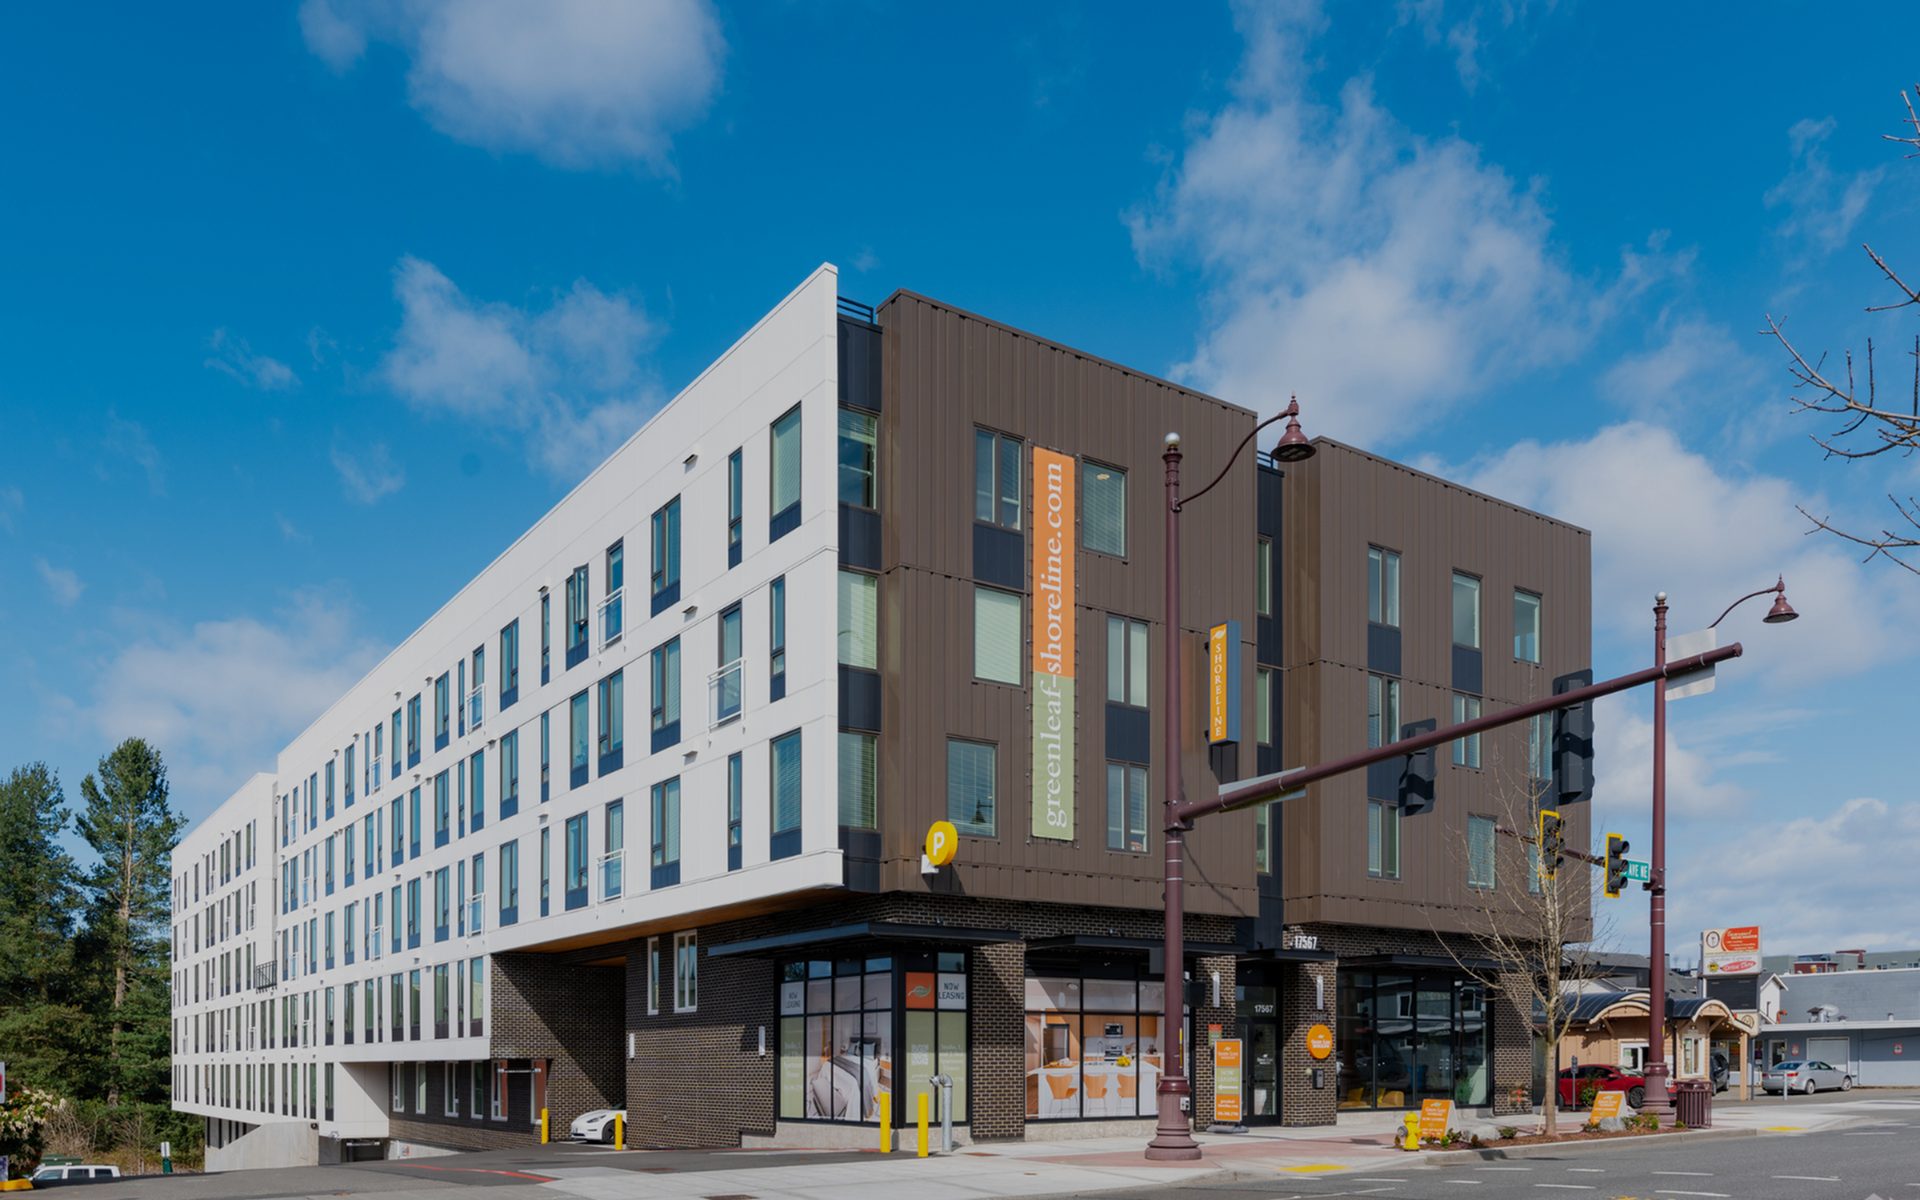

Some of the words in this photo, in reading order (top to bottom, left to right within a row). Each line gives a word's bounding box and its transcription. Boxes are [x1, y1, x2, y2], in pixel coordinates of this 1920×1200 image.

[1040, 463, 1067, 828] greenleaf-shoreline.com
[1214, 643, 1222, 737] SHORELINE
[933, 831, 945, 856] P
[1628, 864, 1639, 877] AVE
[1640, 865, 1648, 879] NE
[1294, 935, 1317, 950] 17567
[943, 982, 960, 990] NOW
[938, 991, 965, 1000] LEASING
[1254, 1004, 1273, 1013] 17567
